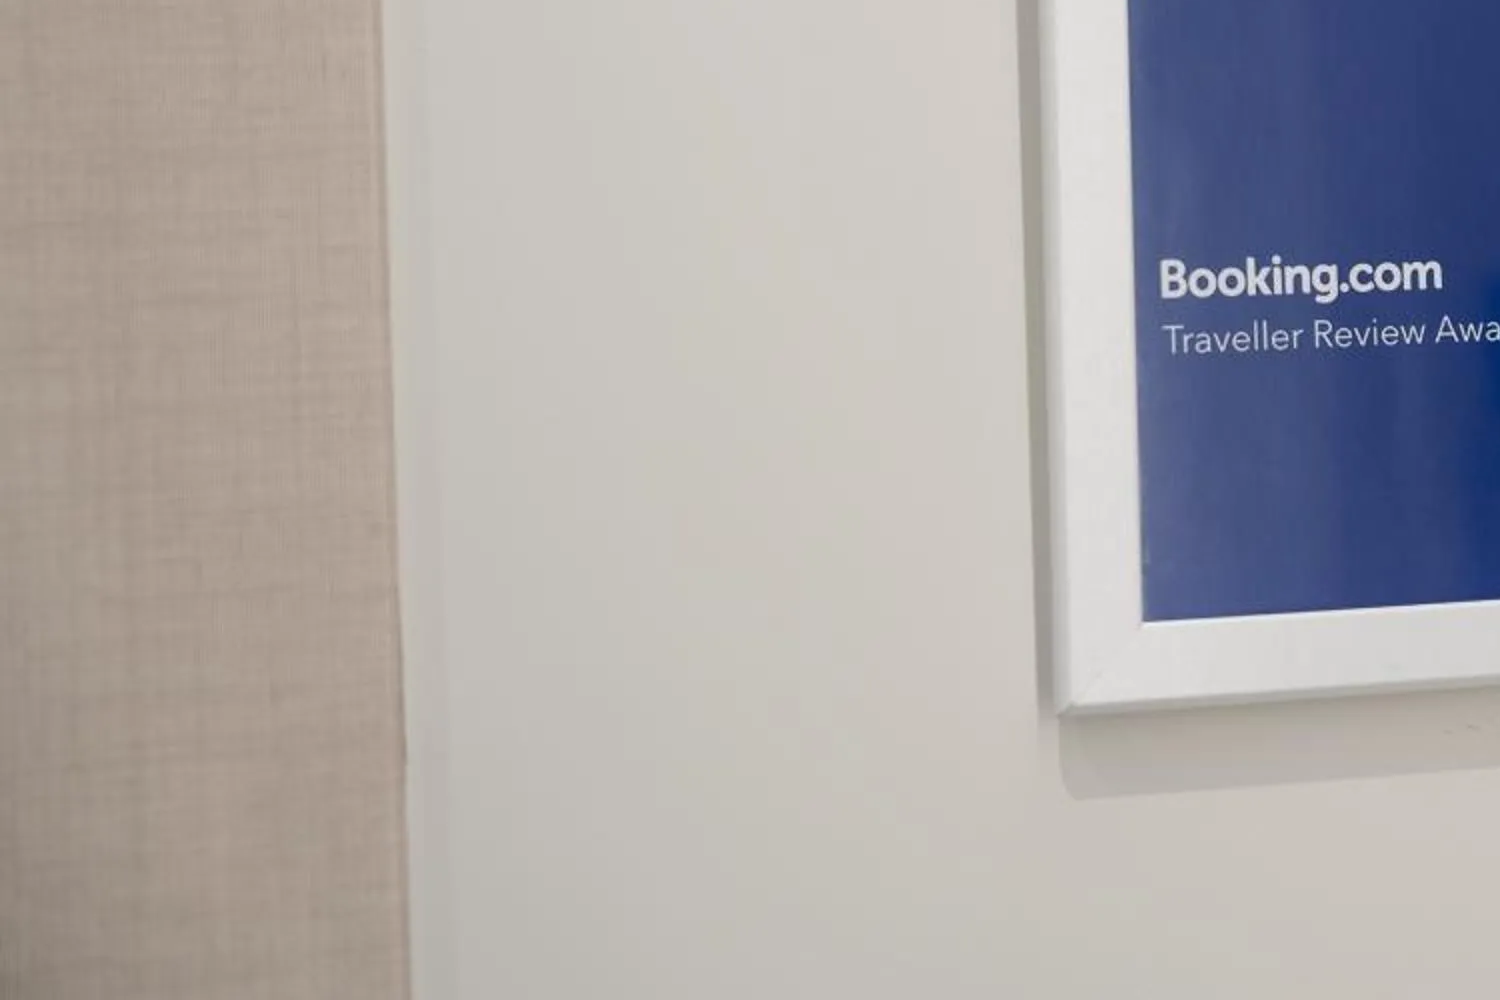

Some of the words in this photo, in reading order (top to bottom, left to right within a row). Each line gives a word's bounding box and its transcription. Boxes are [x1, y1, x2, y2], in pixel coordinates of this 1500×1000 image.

[1159, 254, 1442, 303] Booking.com
[1163, 317, 1304, 356] Traveller
[1315, 317, 1425, 349] Review
